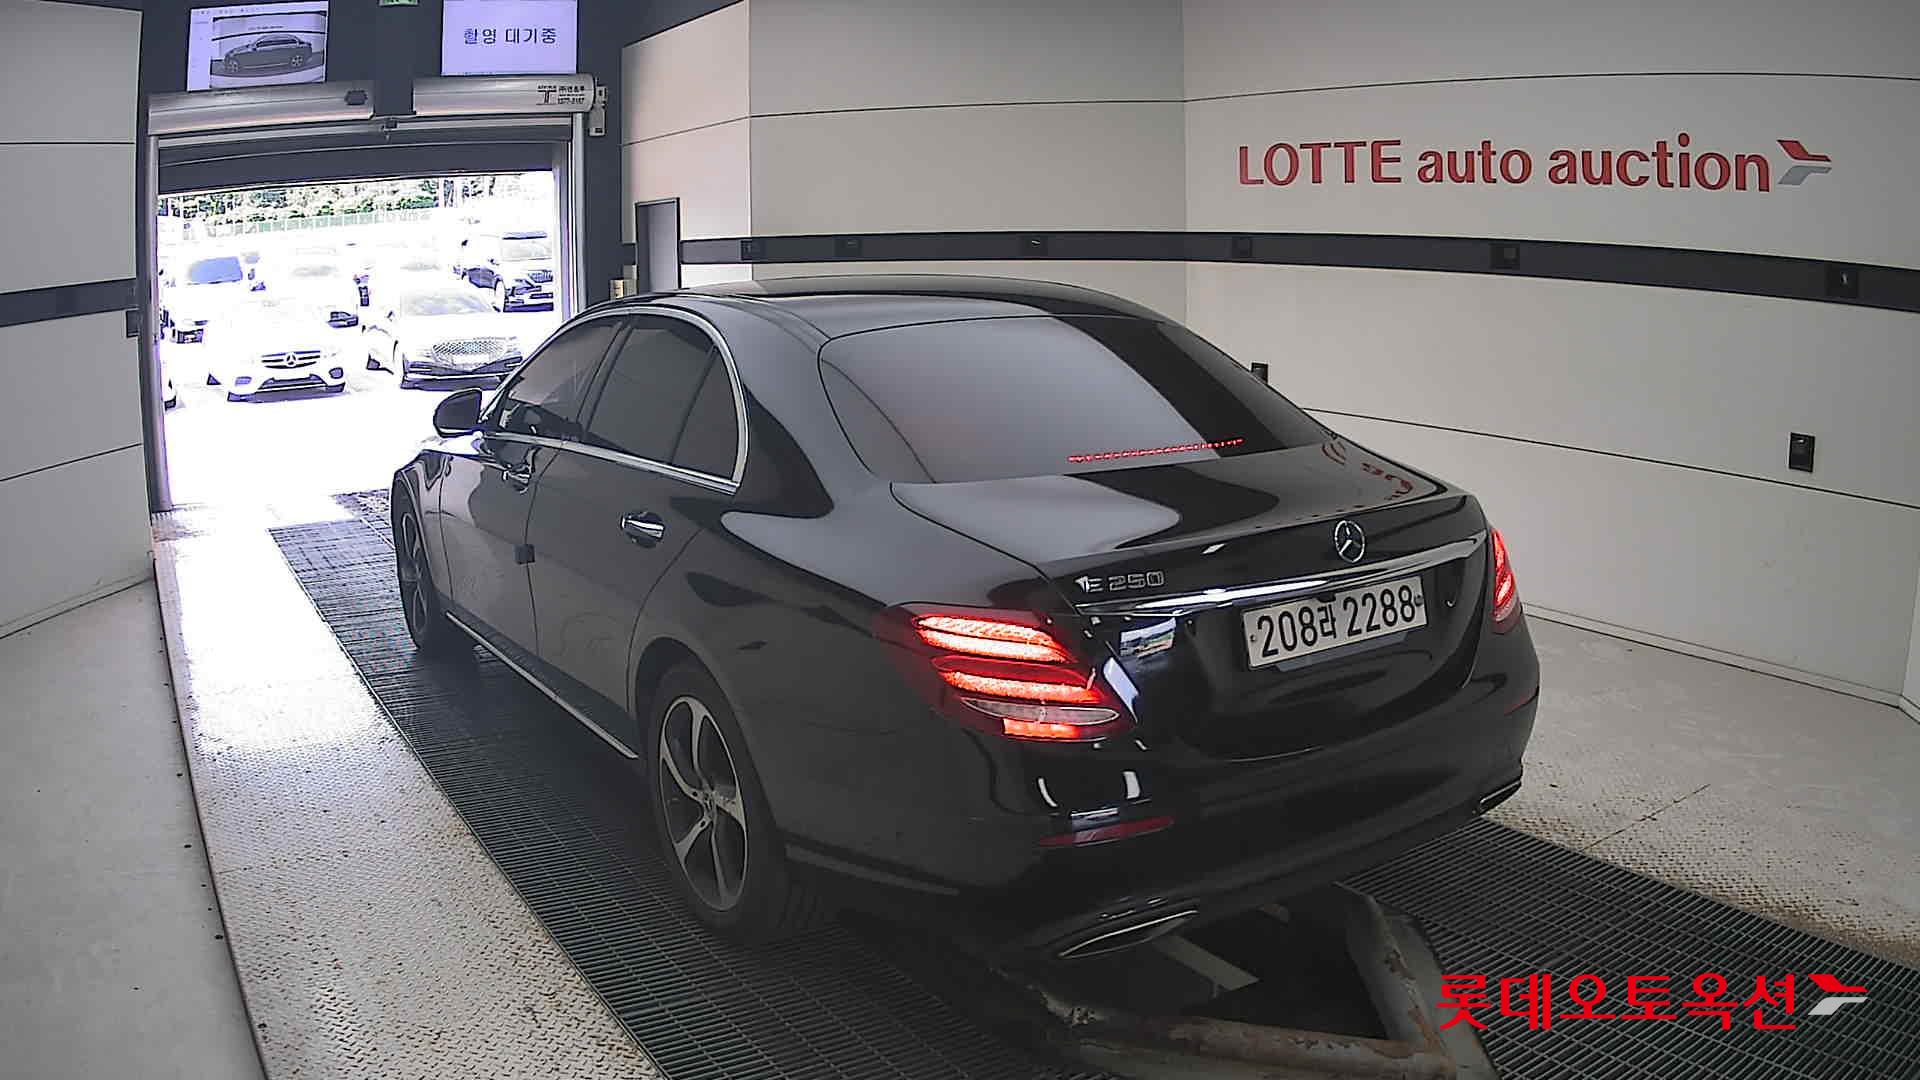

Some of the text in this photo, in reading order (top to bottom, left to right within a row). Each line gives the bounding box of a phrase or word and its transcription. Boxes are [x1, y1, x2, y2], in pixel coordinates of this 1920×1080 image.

[505, 28, 557, 44] 대기중
[1238, 132, 1771, 192] LOTTE auto auction
[1108, 571, 1165, 591] 250
[1257, 585, 1416, 658] 208라 2288
